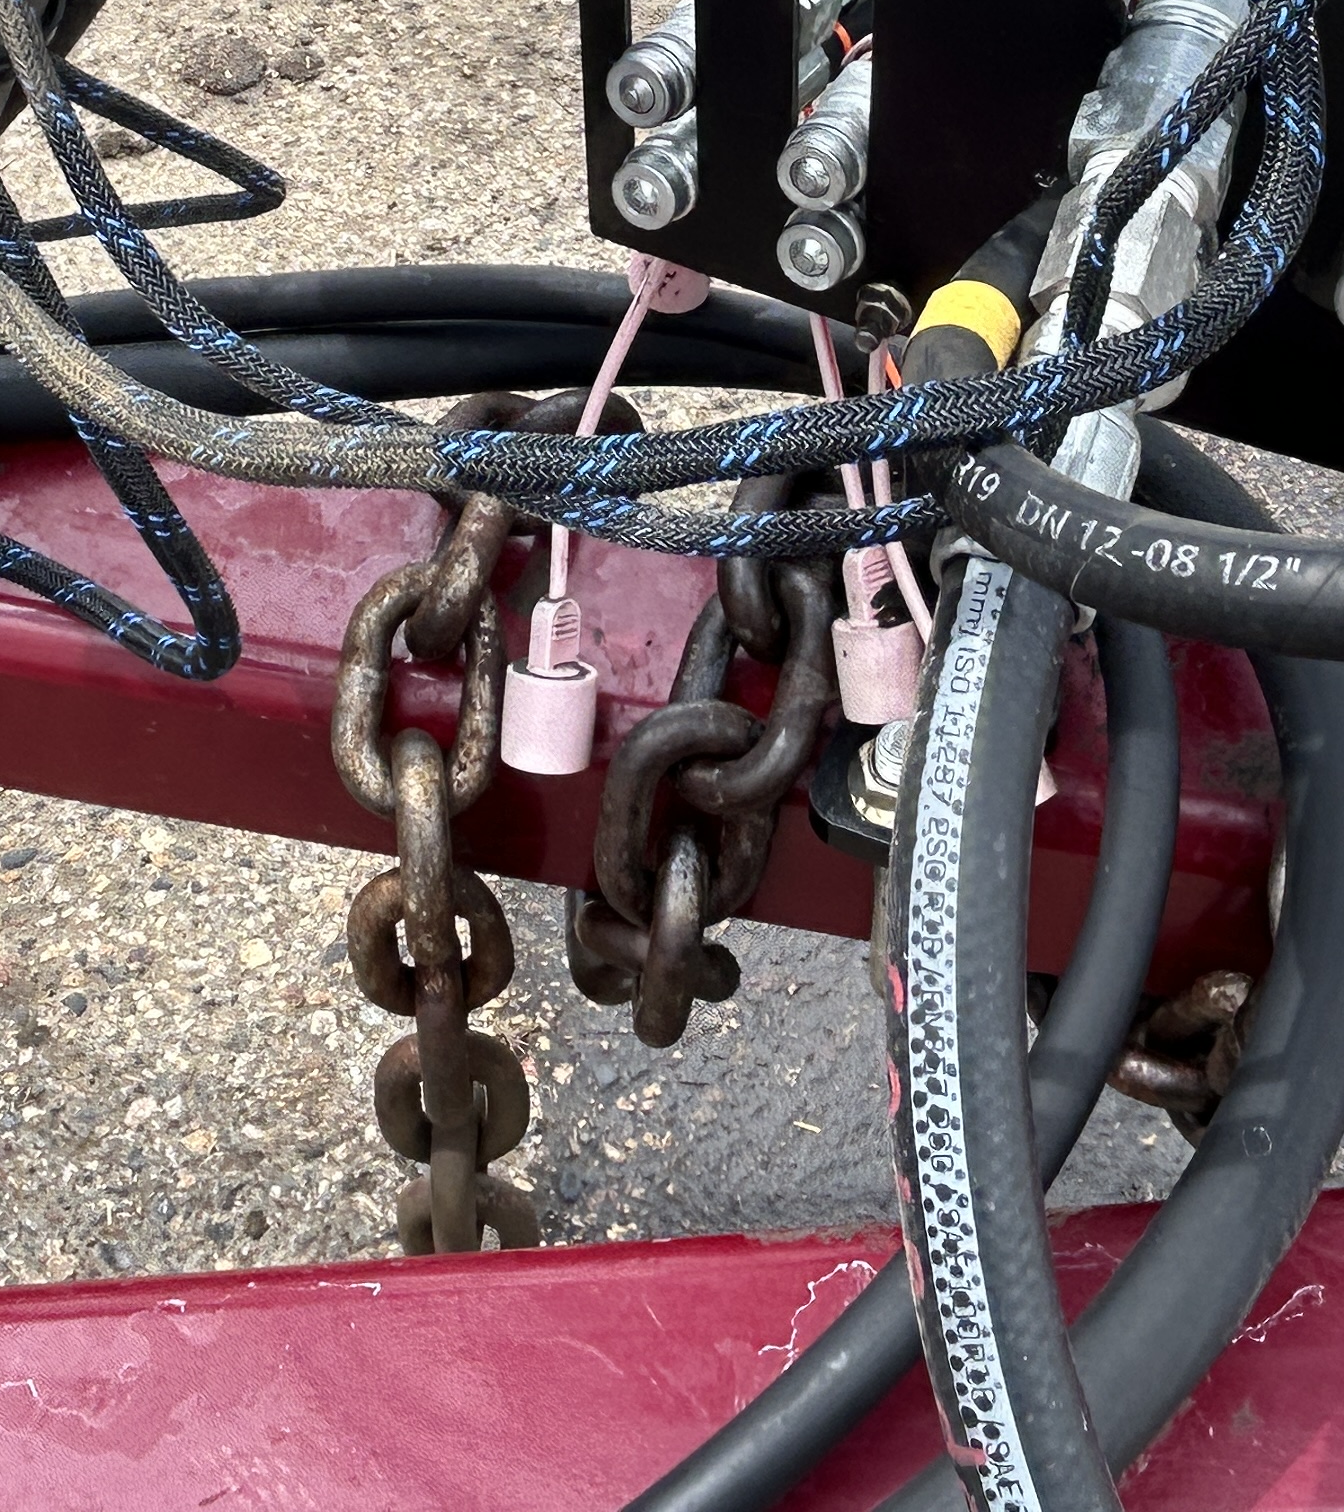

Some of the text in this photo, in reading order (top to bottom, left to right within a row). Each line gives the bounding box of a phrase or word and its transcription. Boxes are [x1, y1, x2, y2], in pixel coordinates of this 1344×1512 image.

[1014, 489, 1073, 541] DN
[1218, 550, 1301, 592] 1/2"
[950, 646, 979, 695] ISO
